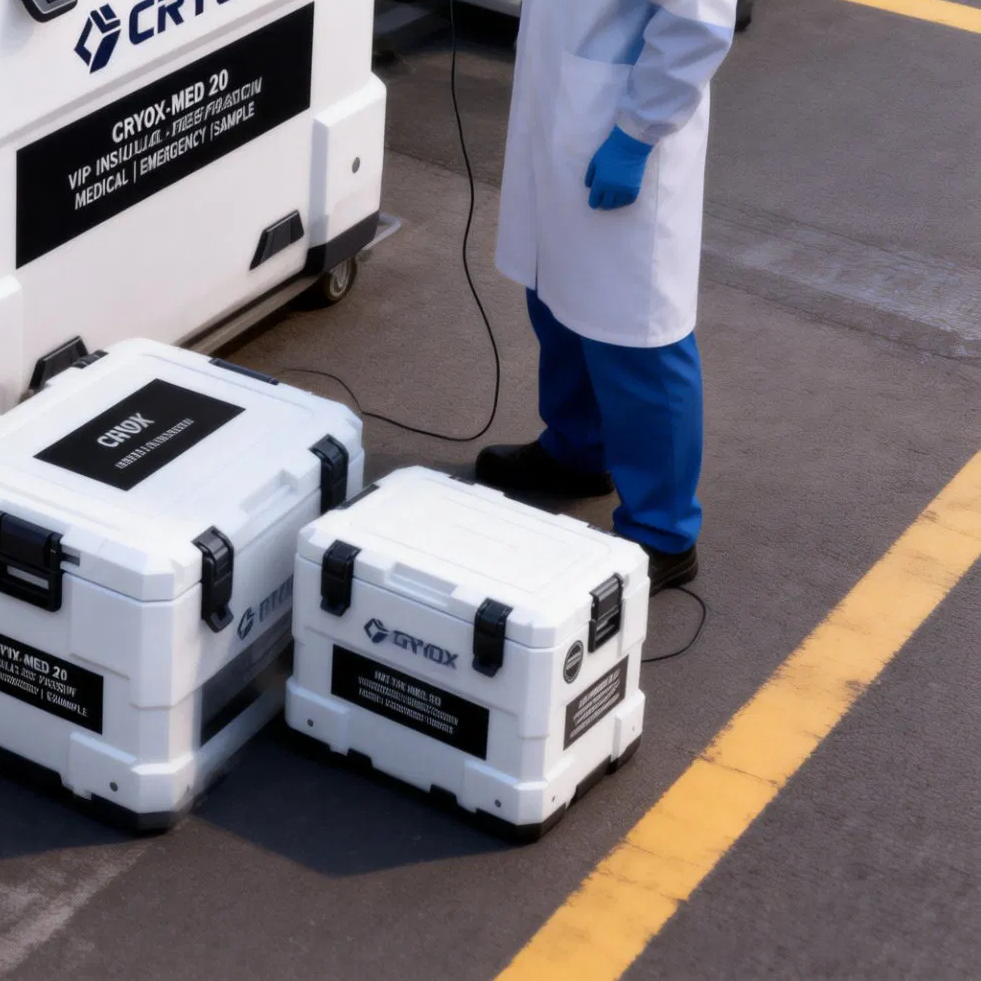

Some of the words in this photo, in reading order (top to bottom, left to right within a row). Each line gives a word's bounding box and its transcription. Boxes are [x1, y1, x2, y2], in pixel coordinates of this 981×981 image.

[111, 81, 205, 144] CRYOX-MED
[208, 68, 229, 97] 20
[68, 165, 92, 191] VIP
[74, 169, 129, 211] MEDICAL
[139, 126, 206, 177] EMERGENCY
[52, 665, 68, 681] 20
